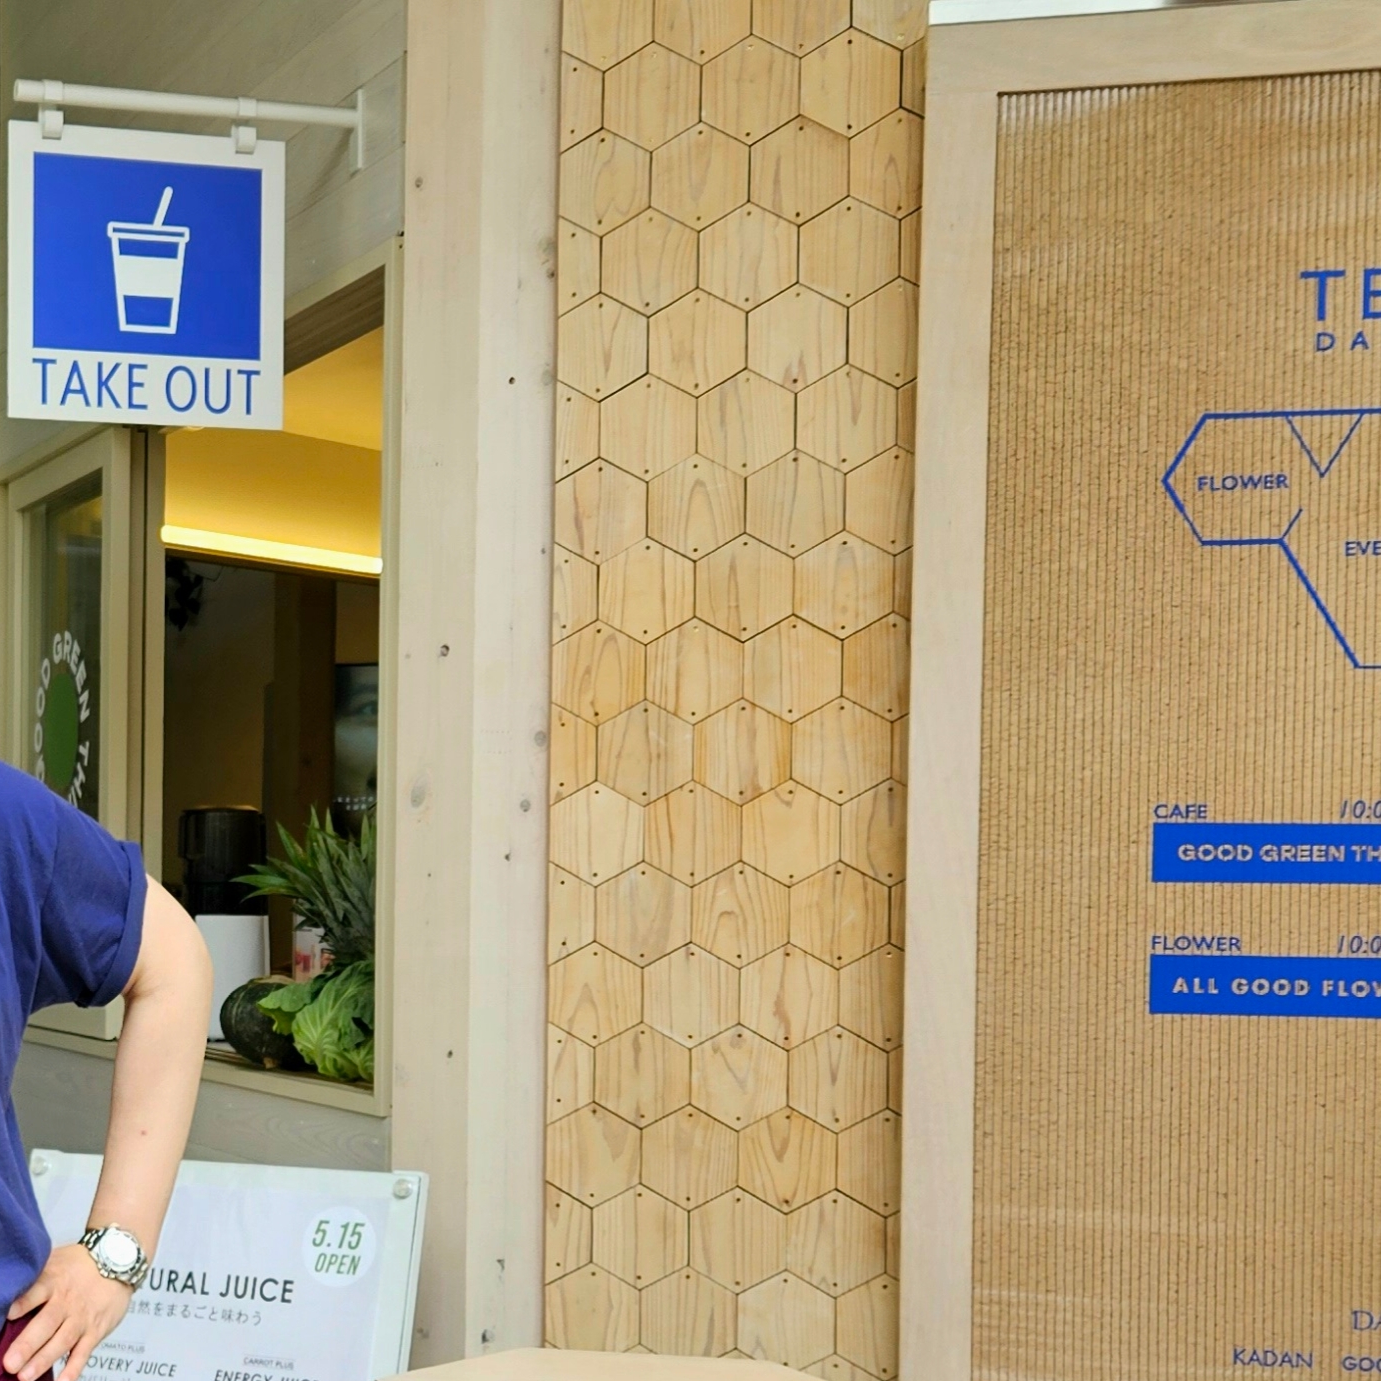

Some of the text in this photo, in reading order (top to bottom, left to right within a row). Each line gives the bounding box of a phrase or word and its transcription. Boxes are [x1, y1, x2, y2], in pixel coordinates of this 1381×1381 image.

[32, 357, 261, 416] TAKE OUT
[1197, 474, 1289, 491] FLOWER
[53, 630, 90, 724] GREEN
[1154, 804, 1208, 819] CAFE
[1178, 844, 1253, 861] GOOD
[1259, 844, 1345, 862] GREEN
[1151, 935, 1242, 952] FLOWER
[1172, 977, 1219, 994] ALL
[1231, 978, 1311, 996] GOOD
[312, 1220, 365, 1250] 5.15
[314, 1253, 361, 1275] OPEN
[149, 1268, 295, 1303] URAL JUICE
[101, 1342, 126, 1351] OMATO
[1232, 1348, 1313, 1369] KADAN
[136, 1361, 177, 1378] JUICE
